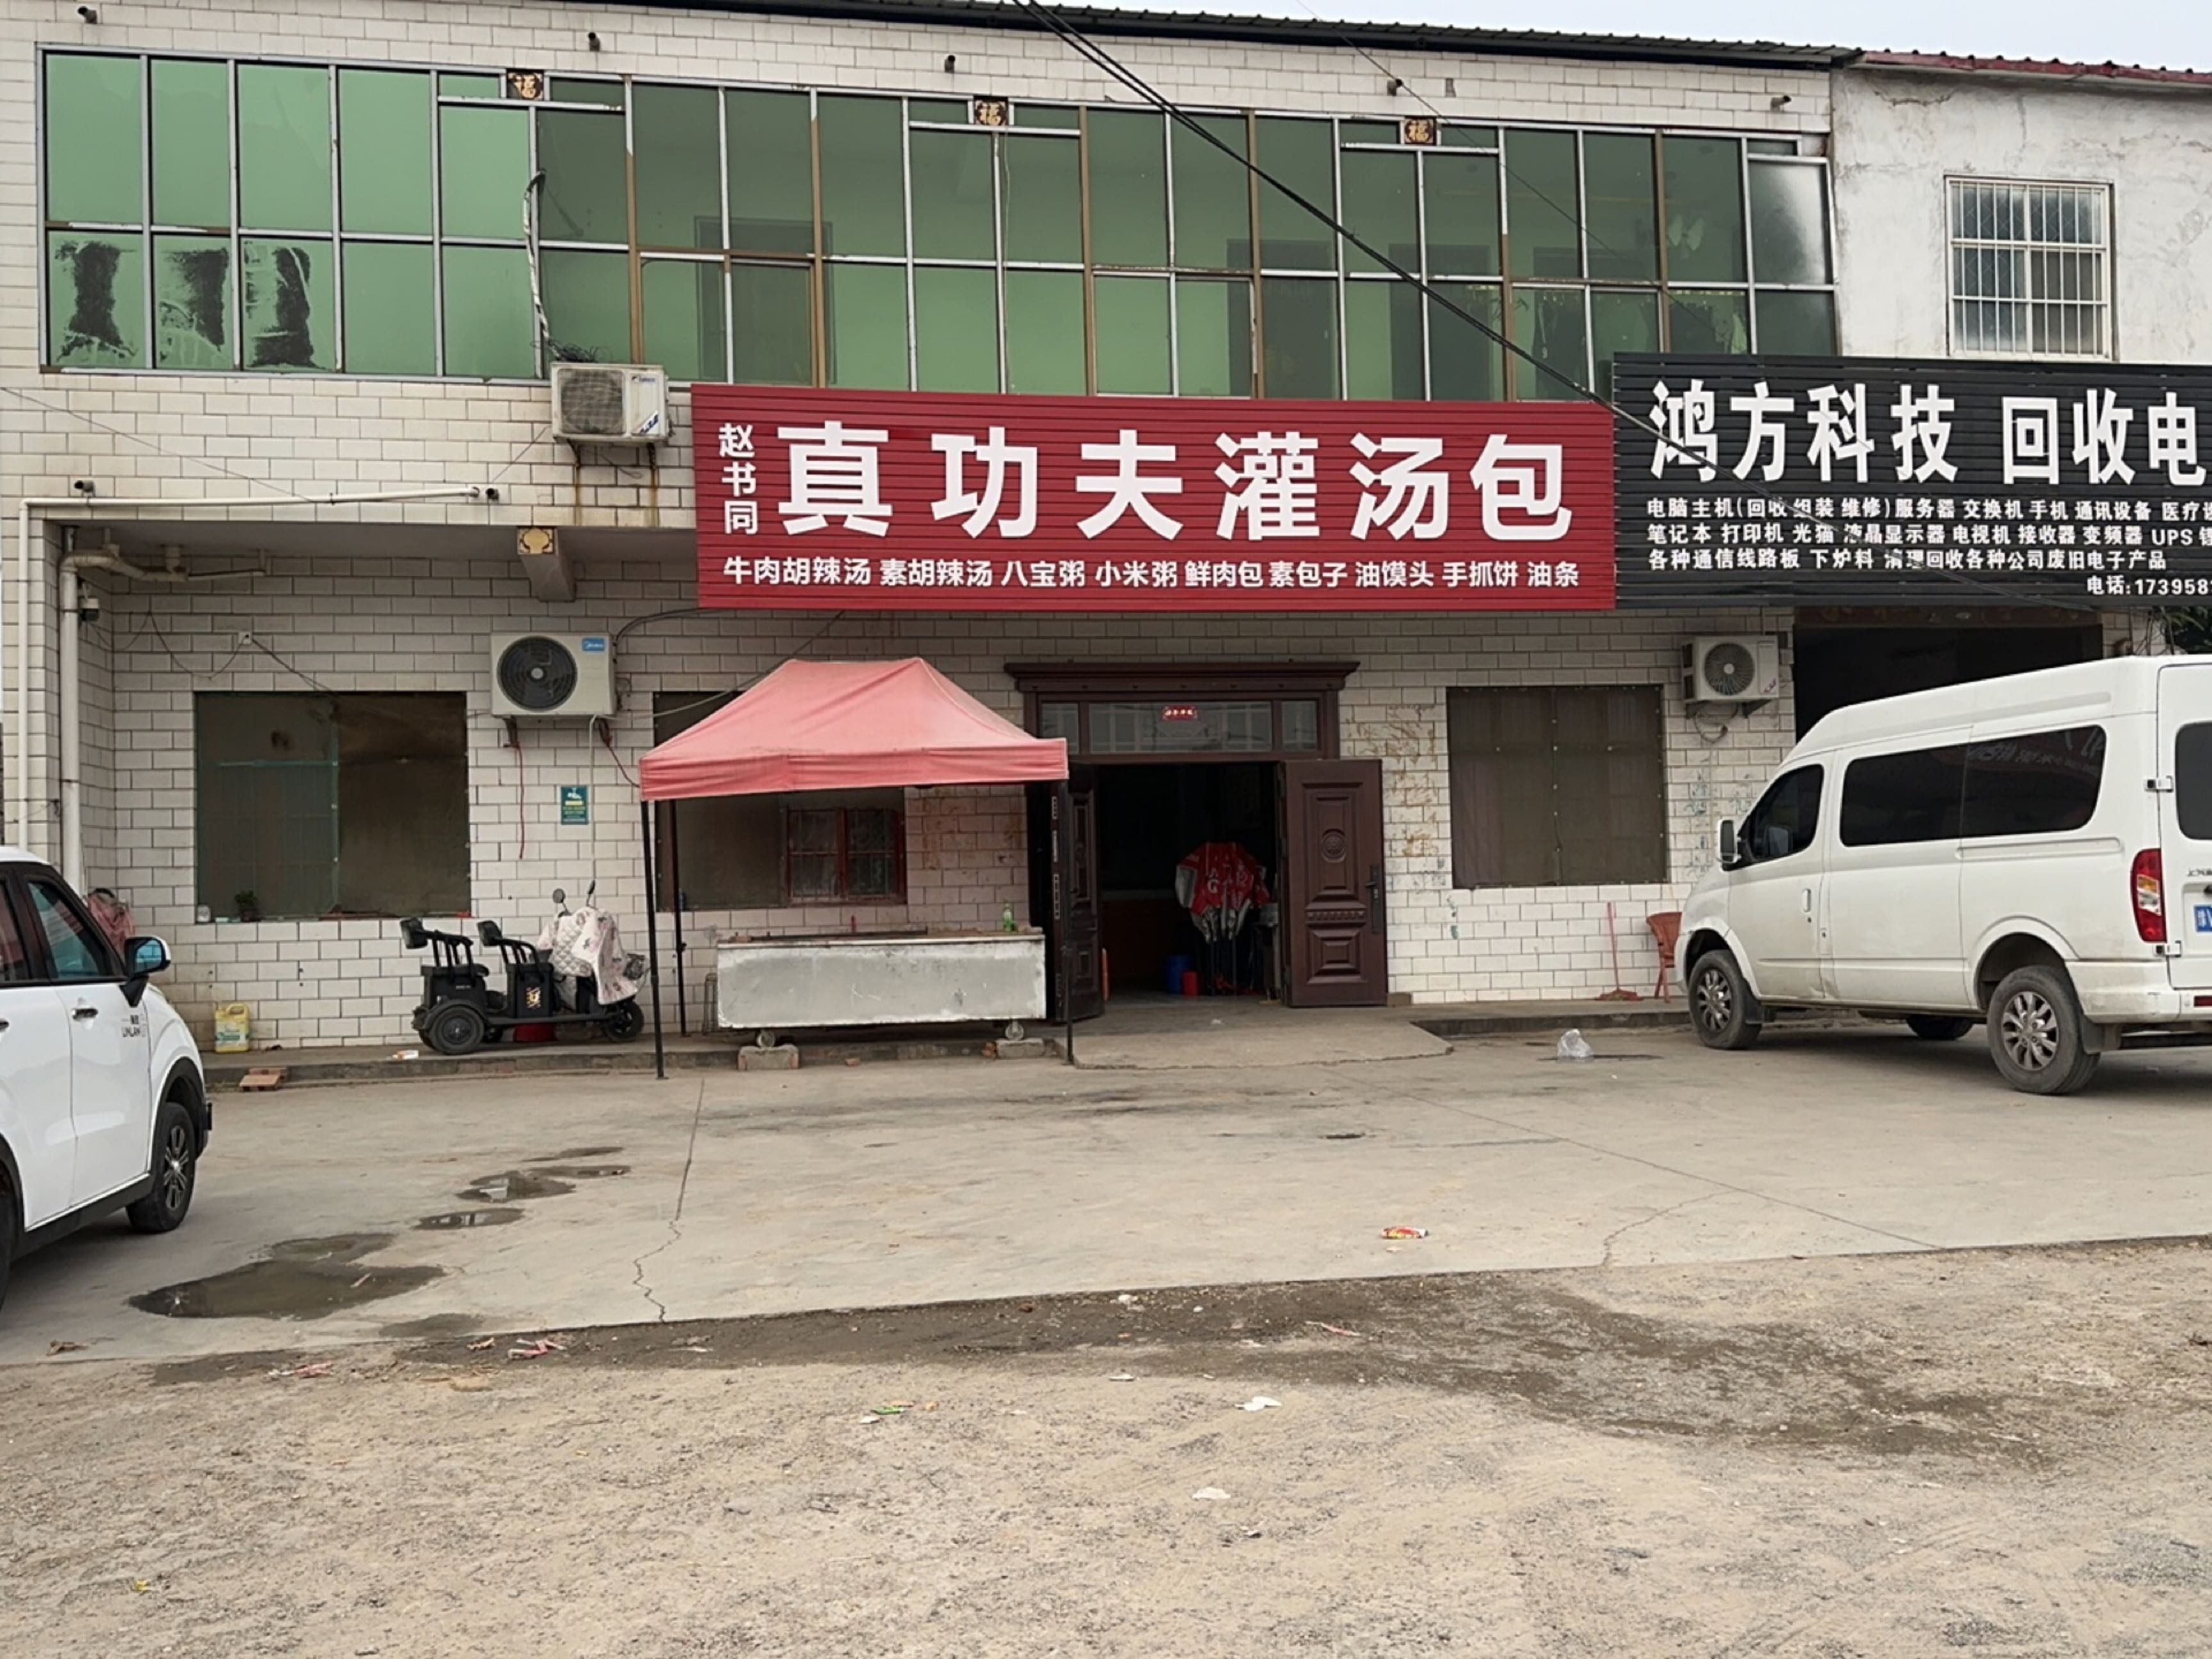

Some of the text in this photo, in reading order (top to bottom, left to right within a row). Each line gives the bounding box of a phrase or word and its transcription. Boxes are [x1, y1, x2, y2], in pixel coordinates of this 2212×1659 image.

[1649, 378, 2208, 486] 鸿方科技 回收电
[717, 422, 758, 535] 赵书同
[777, 420, 1573, 541] 真功夫灌汤包
[1962, 499, 2024, 520] 交换机
[2029, 499, 2069, 520] 手机
[2074, 500, 2152, 521] 通讯设备
[1647, 522, 1712, 545] 笔记本
[1721, 522, 1784, 544] 打印机
[1792, 522, 1834, 544] 光猫
[1843, 524, 1946, 545] 液晶显示器
[1953, 524, 2012, 545] 电视机
[2017, 524, 2076, 545] 接收器
[2082, 525, 2142, 545] 变频器
[2151, 529, 2193, 546] UPS
[723, 555, 1579, 588] 牛肉胡辣汤 素胡辣汤 八宝粥 小米粥 鲜肉包 素包子 油馍头 手抓饼 油条
[1648, 548, 1800, 571] 各种通信线路板
[1809, 549, 1874, 570] 下炉料
[2087, 575, 2212, 596] 电话:173958
